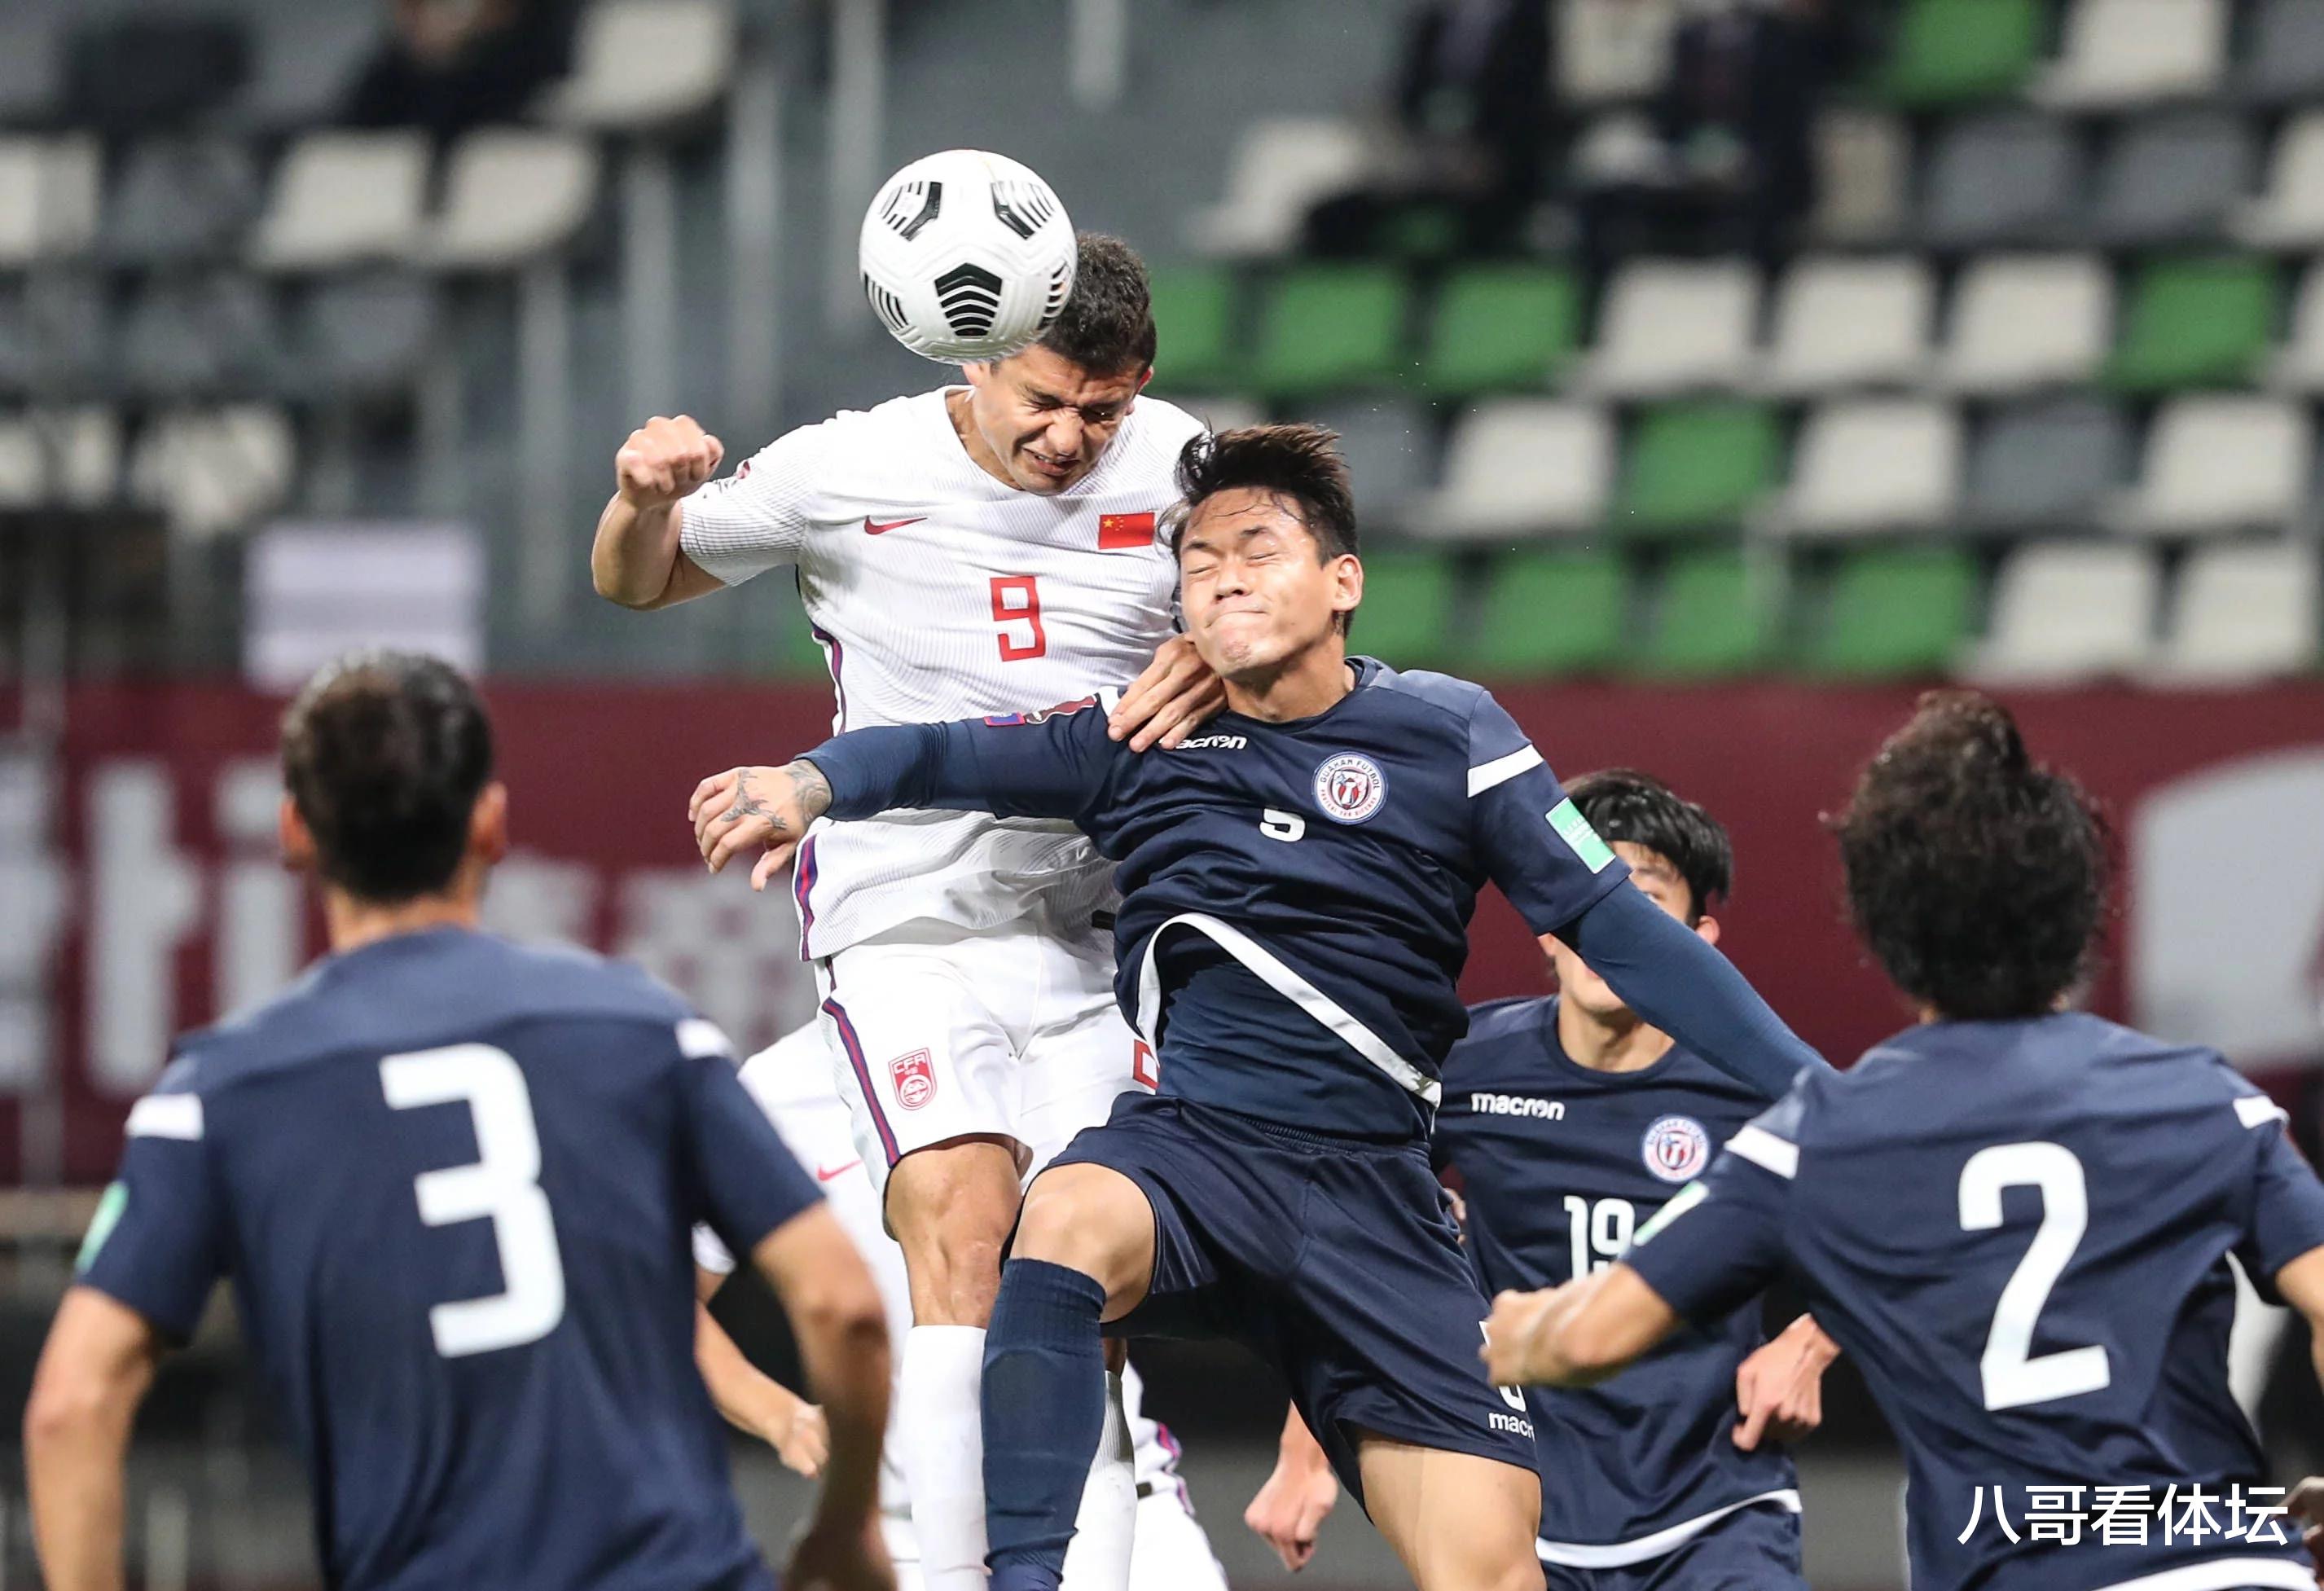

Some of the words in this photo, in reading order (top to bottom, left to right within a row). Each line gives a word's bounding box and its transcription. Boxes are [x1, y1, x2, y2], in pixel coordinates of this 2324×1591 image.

[990, 575, 1046, 662] 9
[1158, 735, 1248, 749] acron
[1470, 1092, 1566, 1121] macron
[379, 1042, 566, 1359] 3
[1564, 1194, 1636, 1282] 19
[1957, 1141, 2111, 1411] 2
[1488, 1412, 1535, 1443] macr
